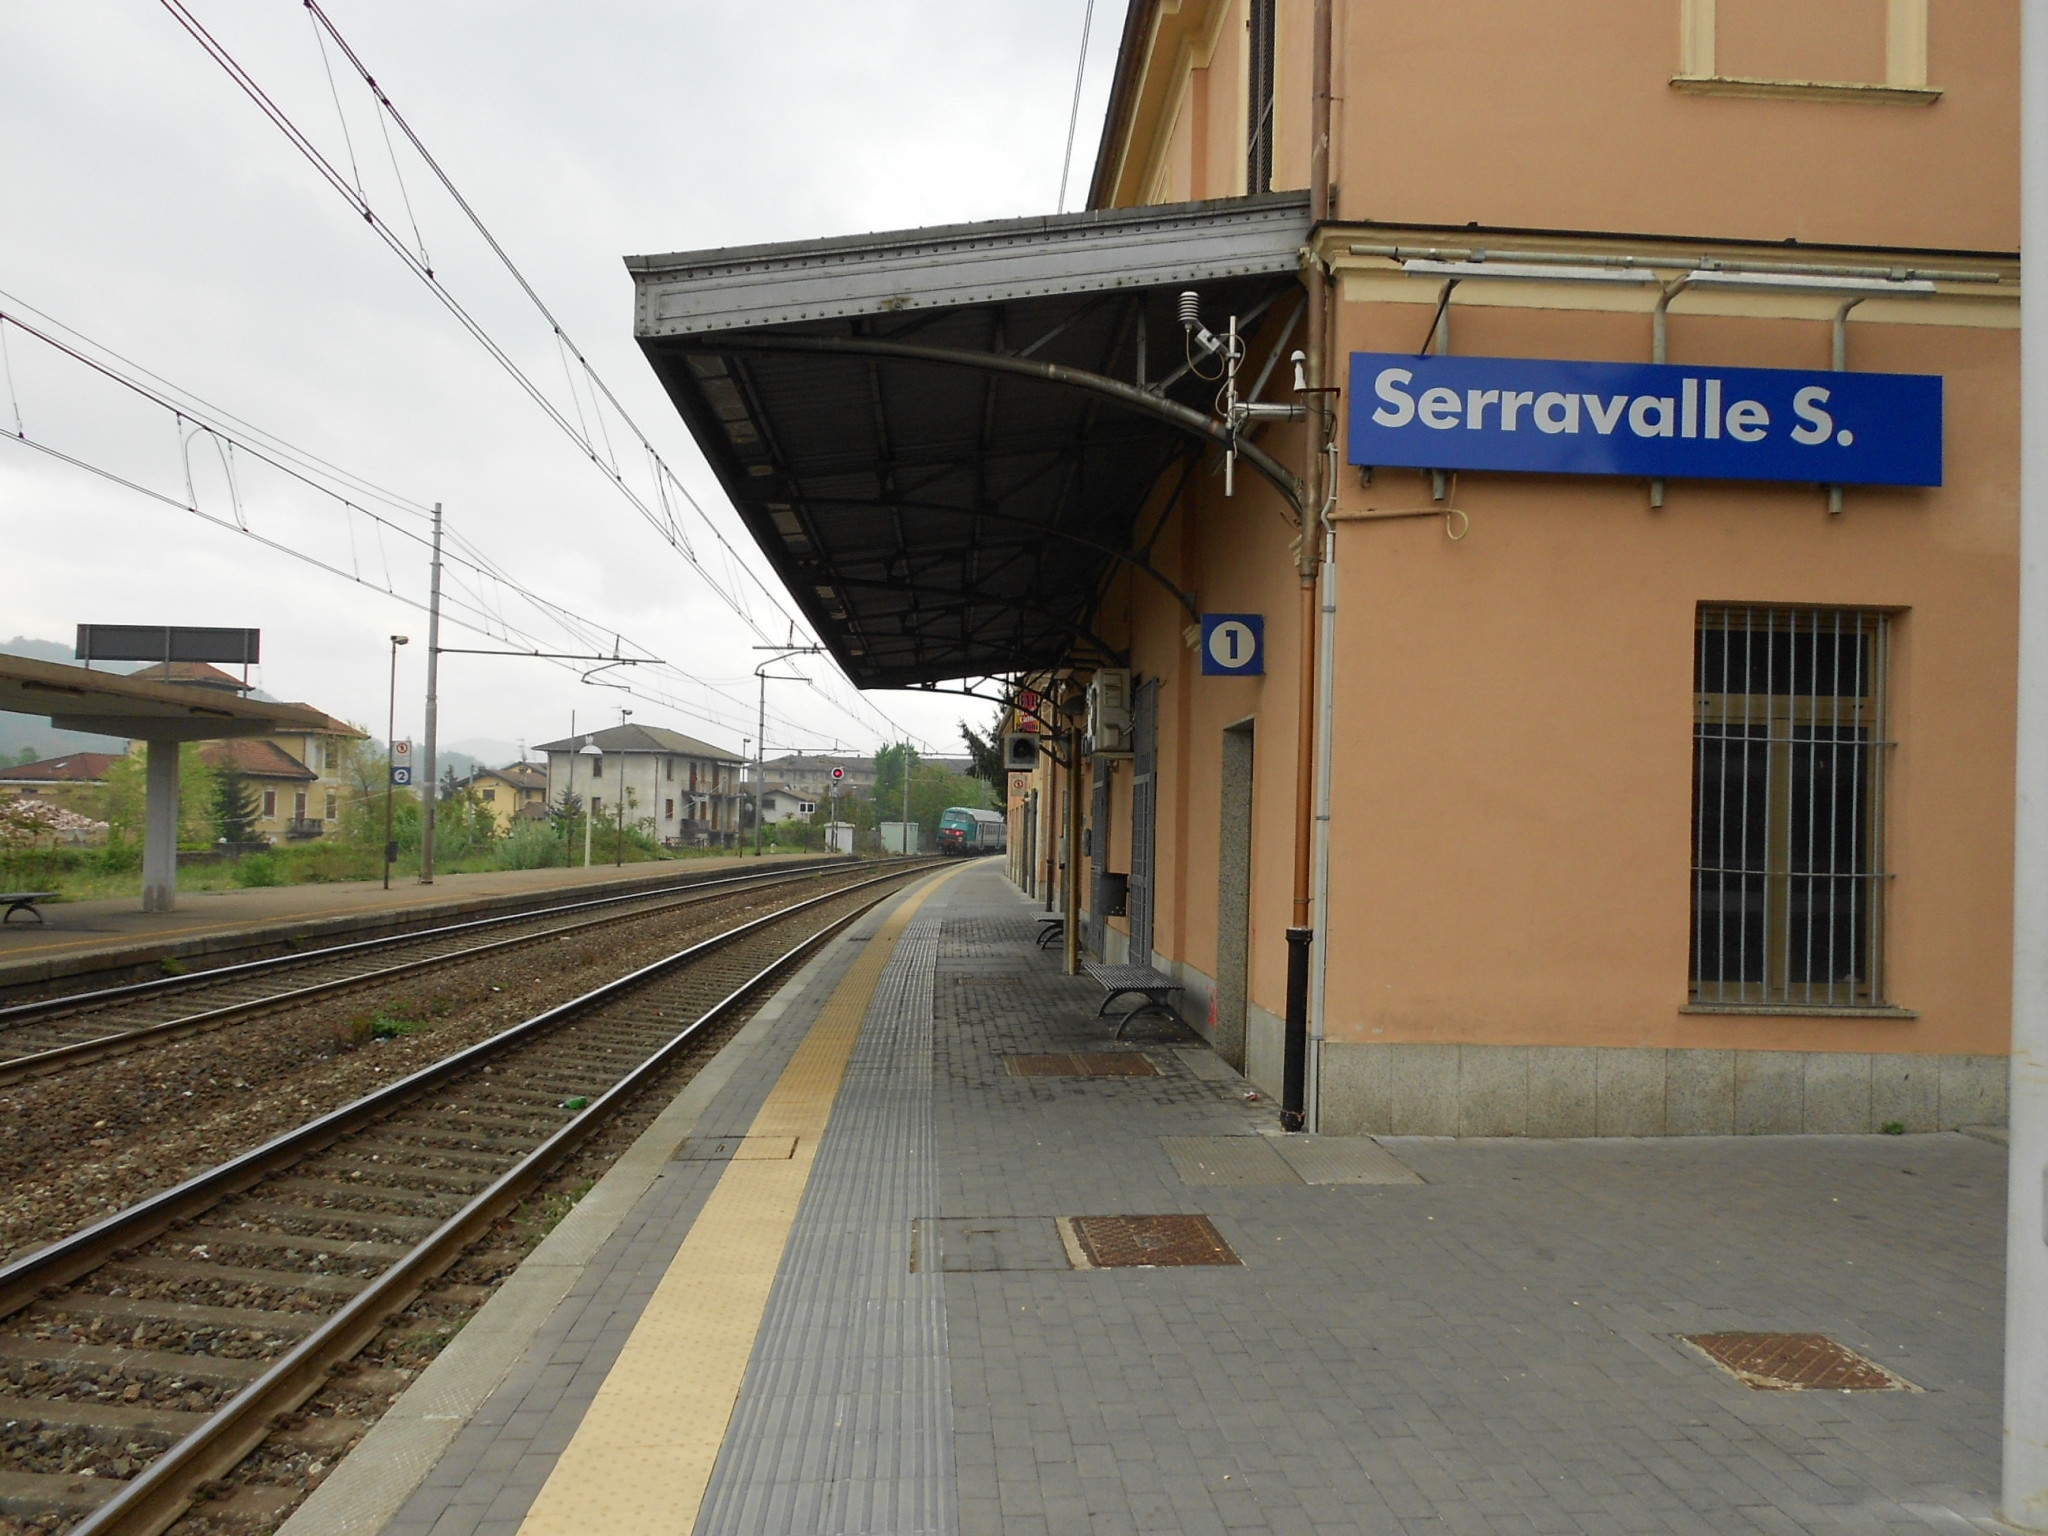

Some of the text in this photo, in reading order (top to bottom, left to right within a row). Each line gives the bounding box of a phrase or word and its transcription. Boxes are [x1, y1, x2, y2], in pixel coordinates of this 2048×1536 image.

[1371, 367, 1854, 447] Serravalle S.
[1225, 629, 1238, 659] 1
